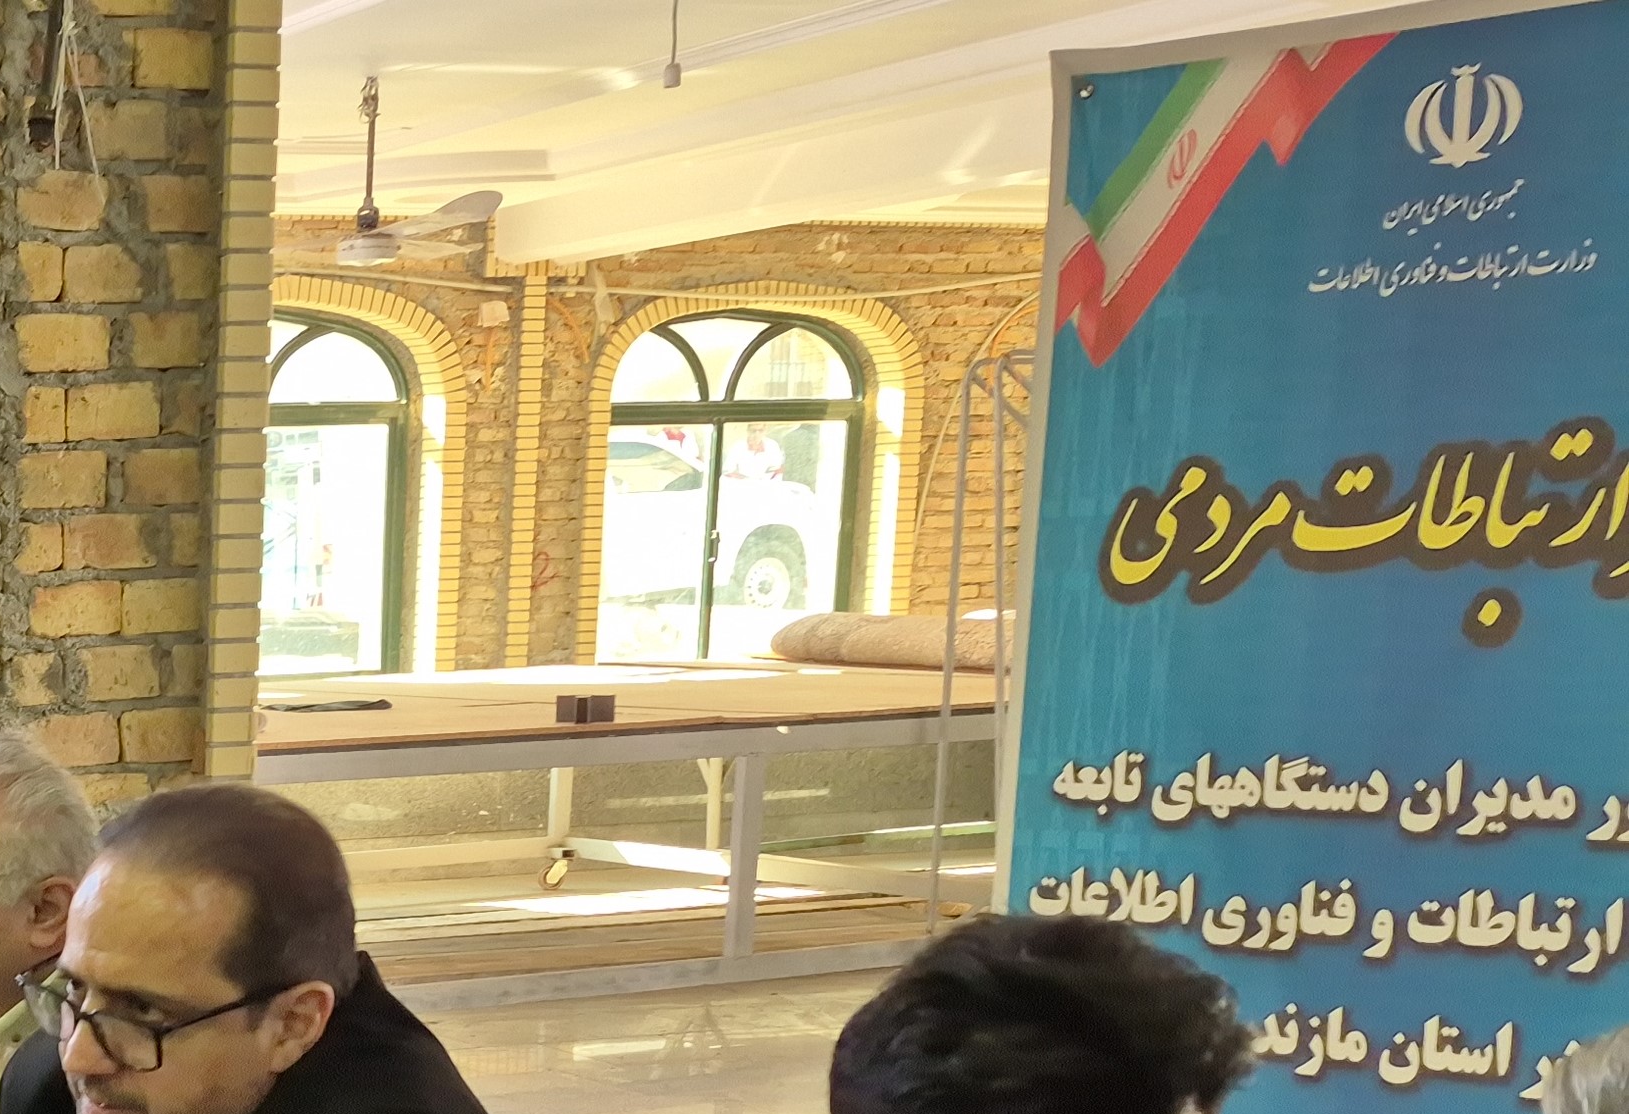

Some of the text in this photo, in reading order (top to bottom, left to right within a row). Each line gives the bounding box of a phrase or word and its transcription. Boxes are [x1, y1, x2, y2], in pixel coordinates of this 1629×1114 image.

[1382, 178, 1525, 237] جمهوری اسلامی ایران
[1307, 257, 1381, 292] اطلاعات
[1378, 241, 1442, 297] فناوری
[1445, 244, 1529, 291] ارتباطات
[1526, 237, 1599, 276] وزارت
[1109, 428, 1629, 626] ارتباطات مردمی
[1054, 749, 1146, 815] تابعه
[1150, 753, 1389, 821] دستگاههای
[1400, 758, 1576, 836] مدیران
[1029, 866, 1625, 974] ارتباطات و فناوری اطلاعات
[1251, 1002, 1369, 1077] مازند
[1378, 1013, 1514, 1086] استان
